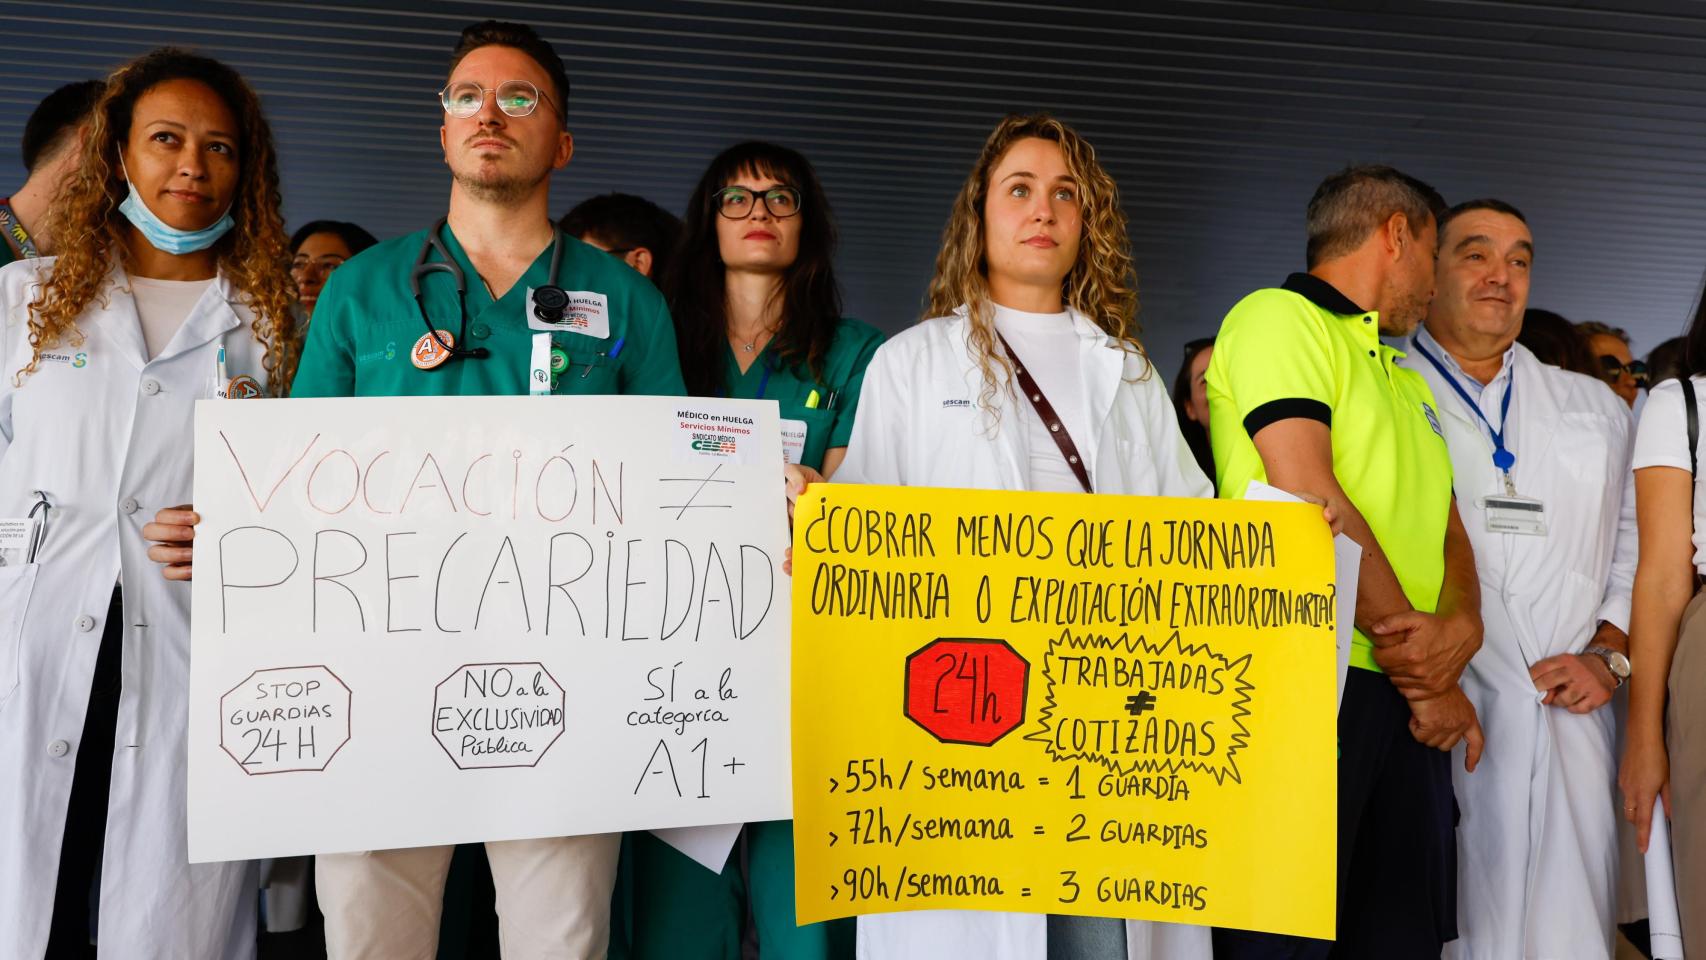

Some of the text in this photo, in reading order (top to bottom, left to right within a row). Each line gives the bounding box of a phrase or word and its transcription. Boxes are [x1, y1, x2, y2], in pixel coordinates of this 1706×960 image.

[573, 298, 602, 307] HUELGA
[677, 410, 754, 425] MÉDICO en HUELGA
[680, 421, 715, 432] Servicios
[692, 433, 736, 443] SINDICATO MÉDICO
[804, 496, 1276, 571] ¿COBRAR MENOS QUE LA JORNADA
[811, 561, 1338, 633] ORDINARIA O EXPLOTACIÓN EXTRAORDINARIA?
[255, 679, 321, 700] STOP
[463, 667, 550, 699] NO a la
[643, 661, 739, 702] SÍ a la
[934, 652, 1001, 725] 24h
[1057, 653, 1226, 698] TRABAJADAS
[229, 703, 333, 726] GUARDIAS
[626, 705, 730, 736] categoría
[460, 734, 534, 758] Pública
[1054, 716, 1216, 758] COTIZADAS
[1065, 764, 1086, 800] 1
[1097, 773, 1191, 802] GUARDIA
[1065, 813, 1091, 843] 2
[1100, 819, 1208, 850] GUARDIAS
[1058, 870, 1081, 904] 3
[1096, 876, 1208, 911] GUARDIAS
